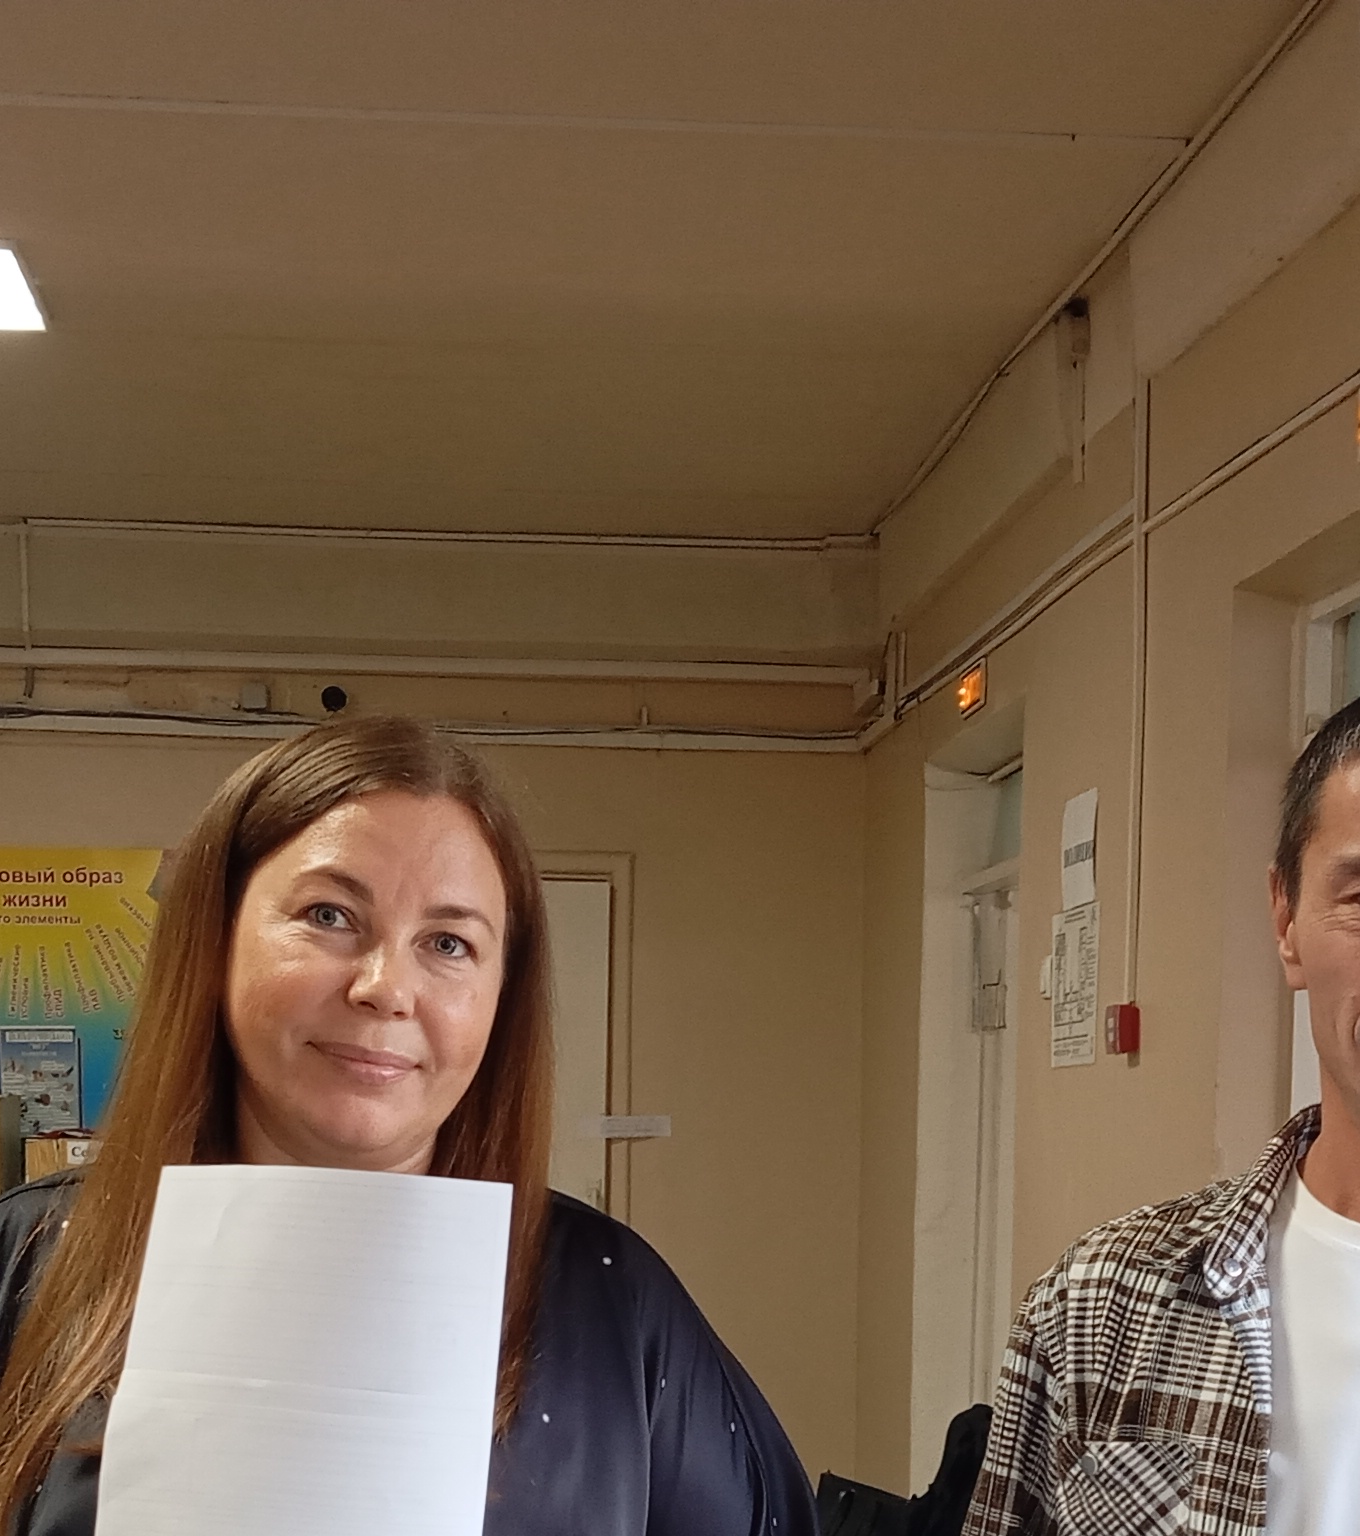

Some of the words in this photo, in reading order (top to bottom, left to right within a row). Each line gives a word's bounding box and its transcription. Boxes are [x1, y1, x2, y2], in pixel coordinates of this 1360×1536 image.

[62, 867, 124, 887] образ
[2, 894, 67, 908] жизни
[15, 915, 81, 924] элементы
[39, 945, 53, 1020] Профилактика
[64, 941, 91, 1014] Профилактика
[92, 943, 126, 1003] Пребывание
[53, 988, 64, 1018] СПИД
[89, 988, 101, 1012] ПАВ
